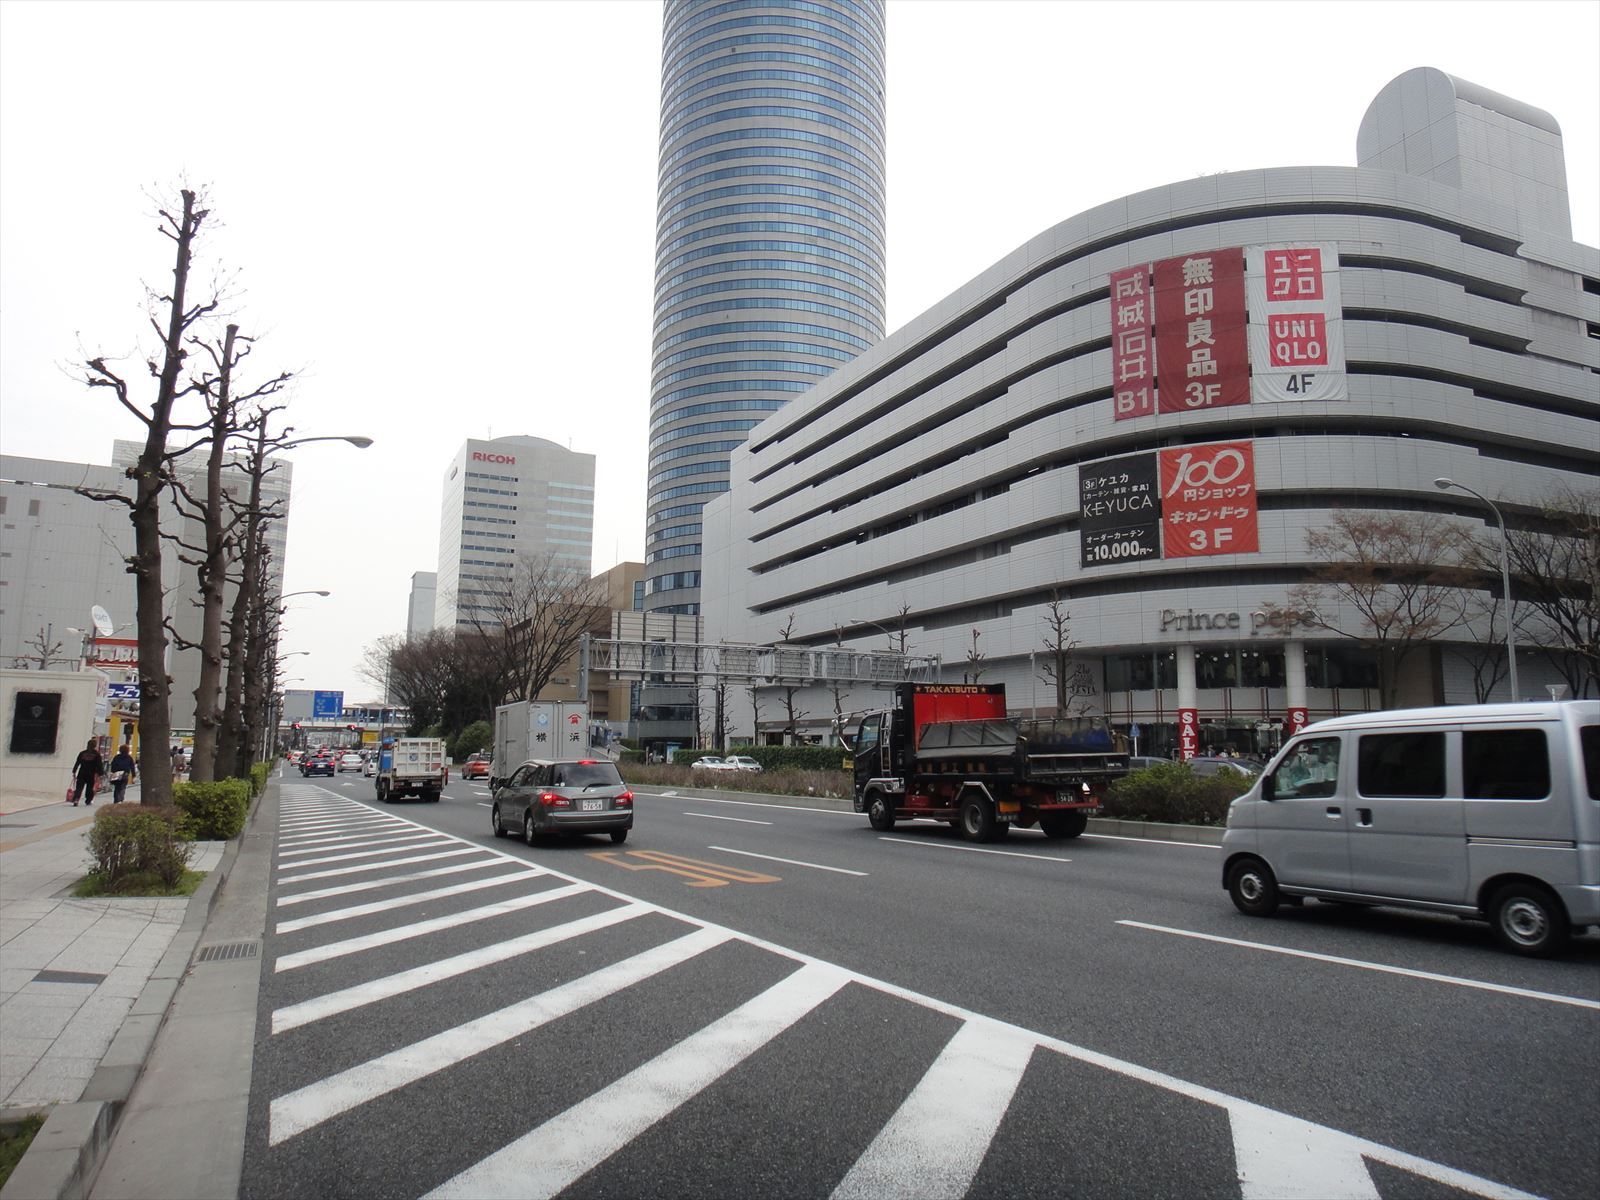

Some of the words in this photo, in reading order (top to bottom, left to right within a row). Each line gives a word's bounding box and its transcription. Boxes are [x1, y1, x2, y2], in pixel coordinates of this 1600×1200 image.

[1116, 271, 1147, 383] 成城石井
[1182, 257, 1217, 378] 無印良品
[1275, 320, 1316, 338] UNI
[1276, 341, 1321, 363] QLO
[1185, 381, 1221, 407] 3F
[1286, 374, 1315, 394] 4F
[1117, 387, 1148, 414] B1
[473, 451, 516, 465] RICOH
[1166, 448, 1245, 499] 100
[1184, 483, 1251, 502] 円ショップ
[1083, 494, 1153, 518] KEYUCA
[1086, 529, 1145, 544] オーダーカーテン
[1160, 608, 1240, 632] Prince
[1250, 610, 1316, 635] pepe
[1182, 711, 1195, 762] SALE
